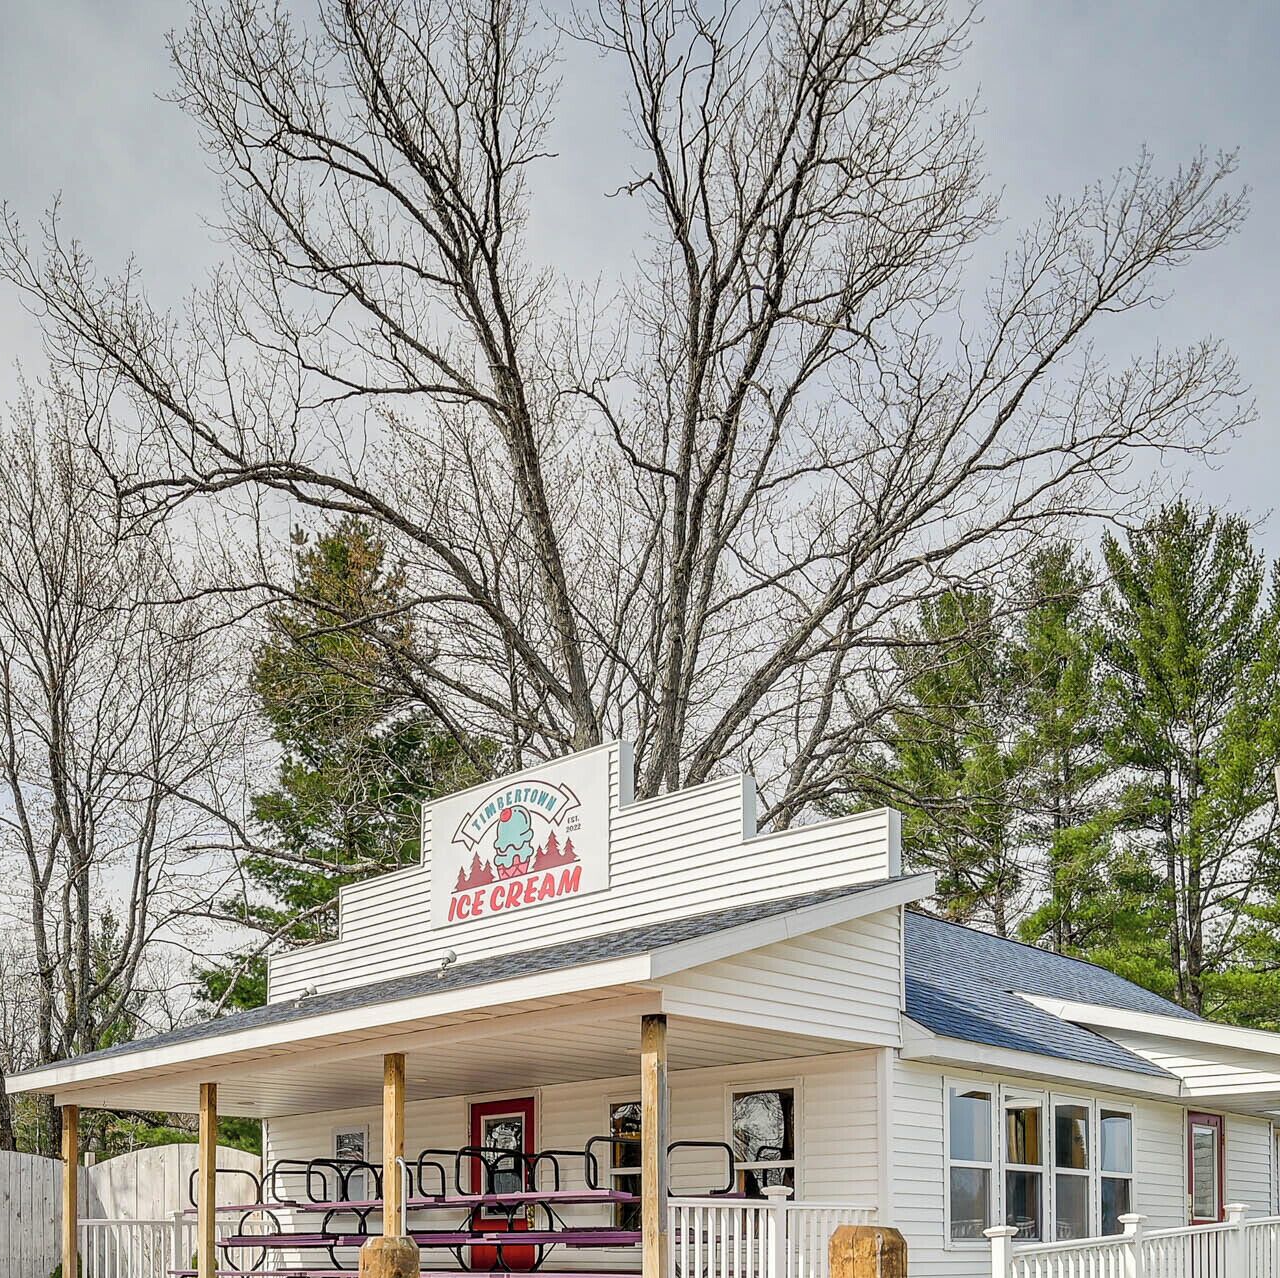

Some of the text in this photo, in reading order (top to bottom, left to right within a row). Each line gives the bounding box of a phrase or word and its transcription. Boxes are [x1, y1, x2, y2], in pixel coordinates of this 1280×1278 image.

[471, 788, 558, 832] TIMBERTOWN
[567, 815, 580, 824] EST.
[566, 823, 581, 833] 2022
[448, 865, 583, 922] ICE CREAM
